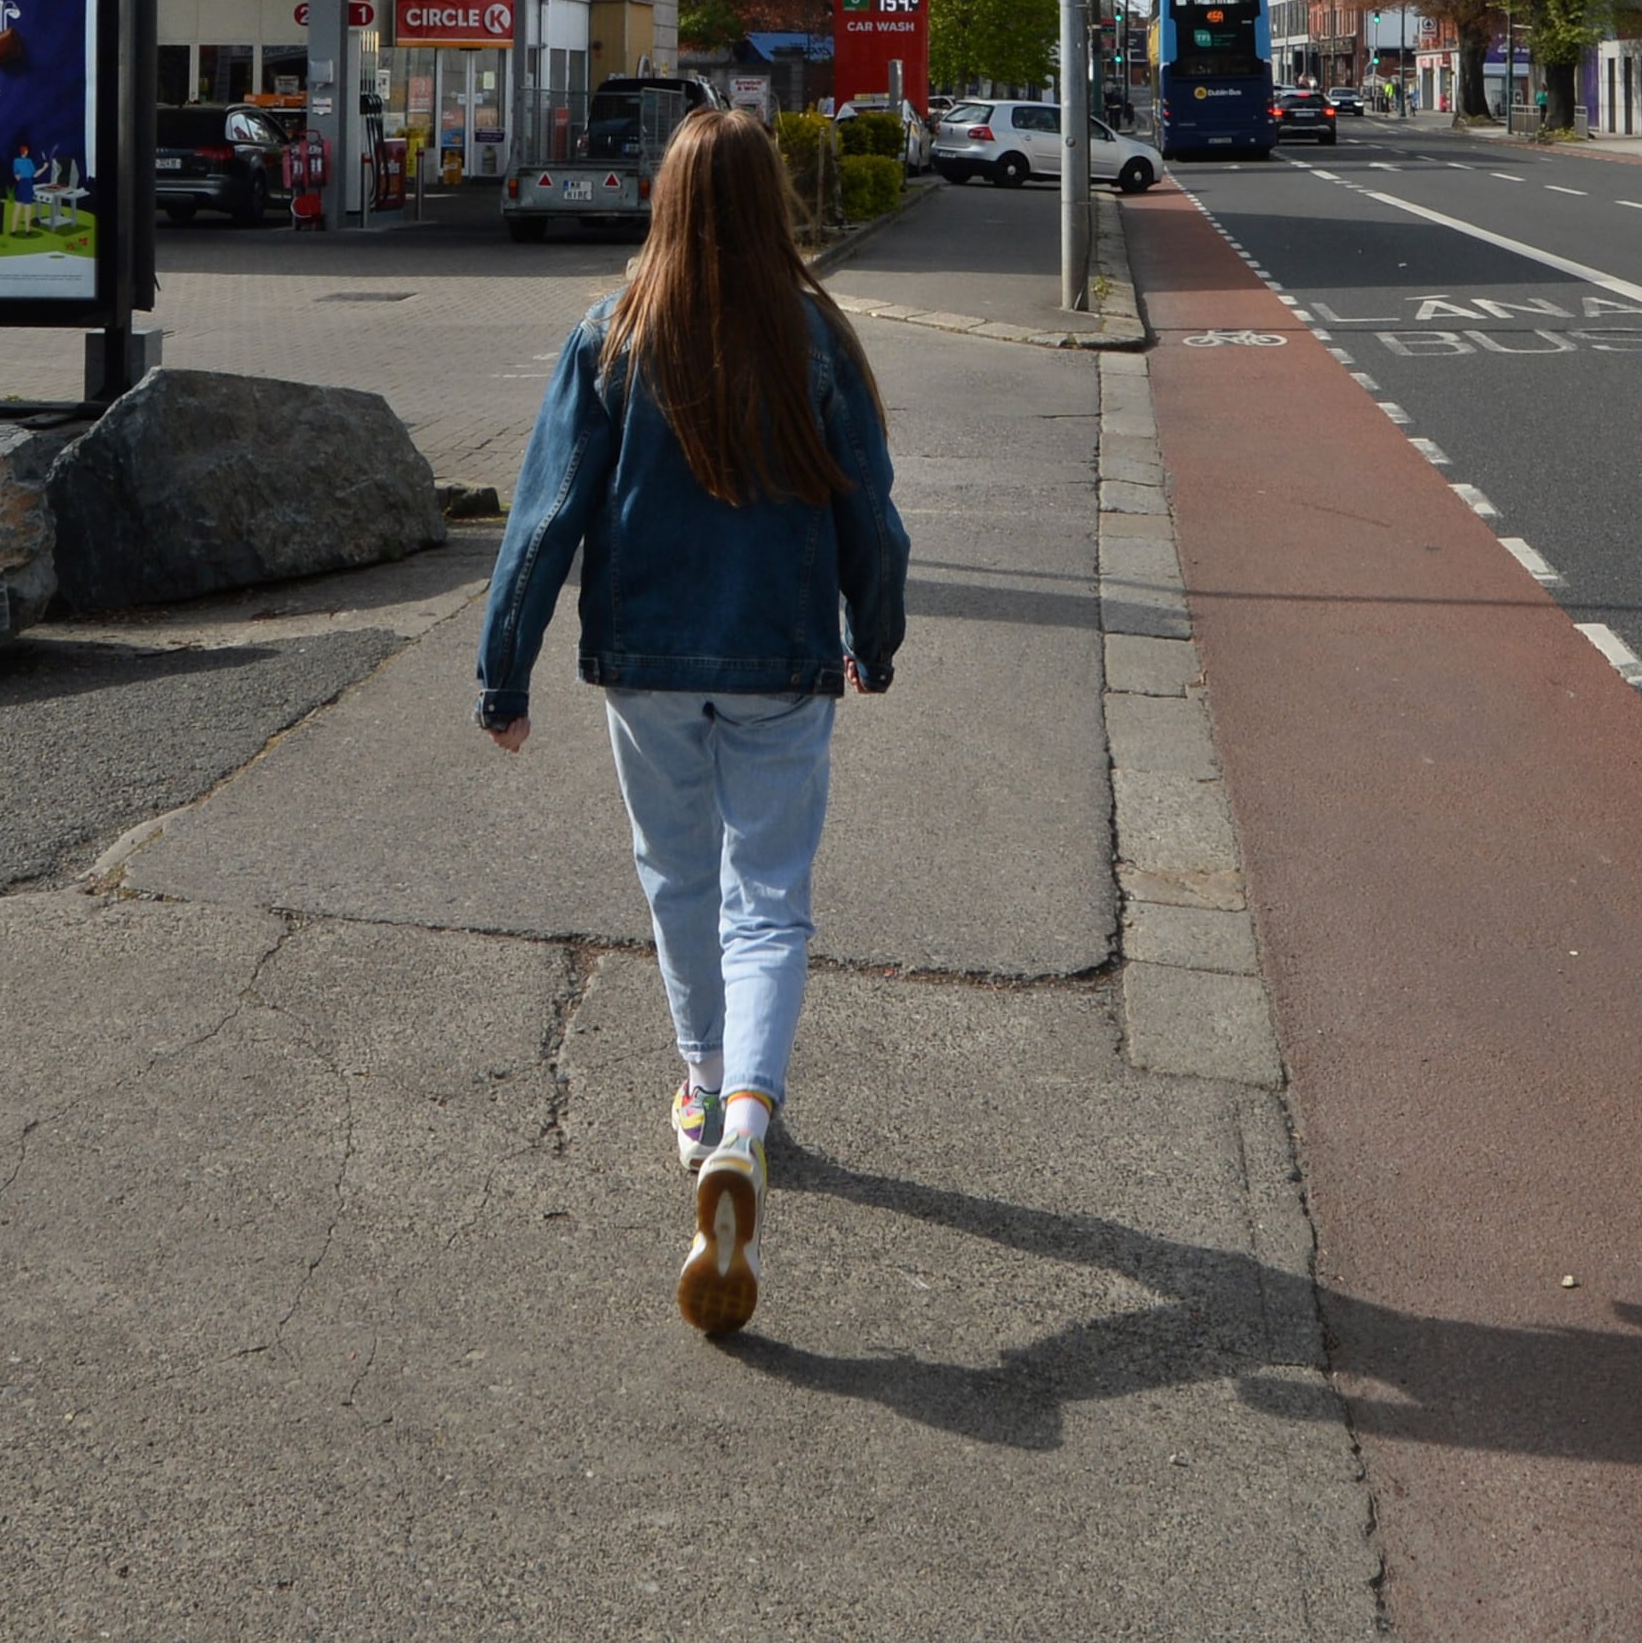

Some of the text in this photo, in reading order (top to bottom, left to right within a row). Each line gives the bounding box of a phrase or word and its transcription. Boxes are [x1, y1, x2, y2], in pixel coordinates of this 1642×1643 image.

[358, 7, 367, 23] 1
[406, 9, 479, 27] CIRCLE
[847, 22, 914, 31] CAR WASH
[1228, 88, 1242, 96] Bus
